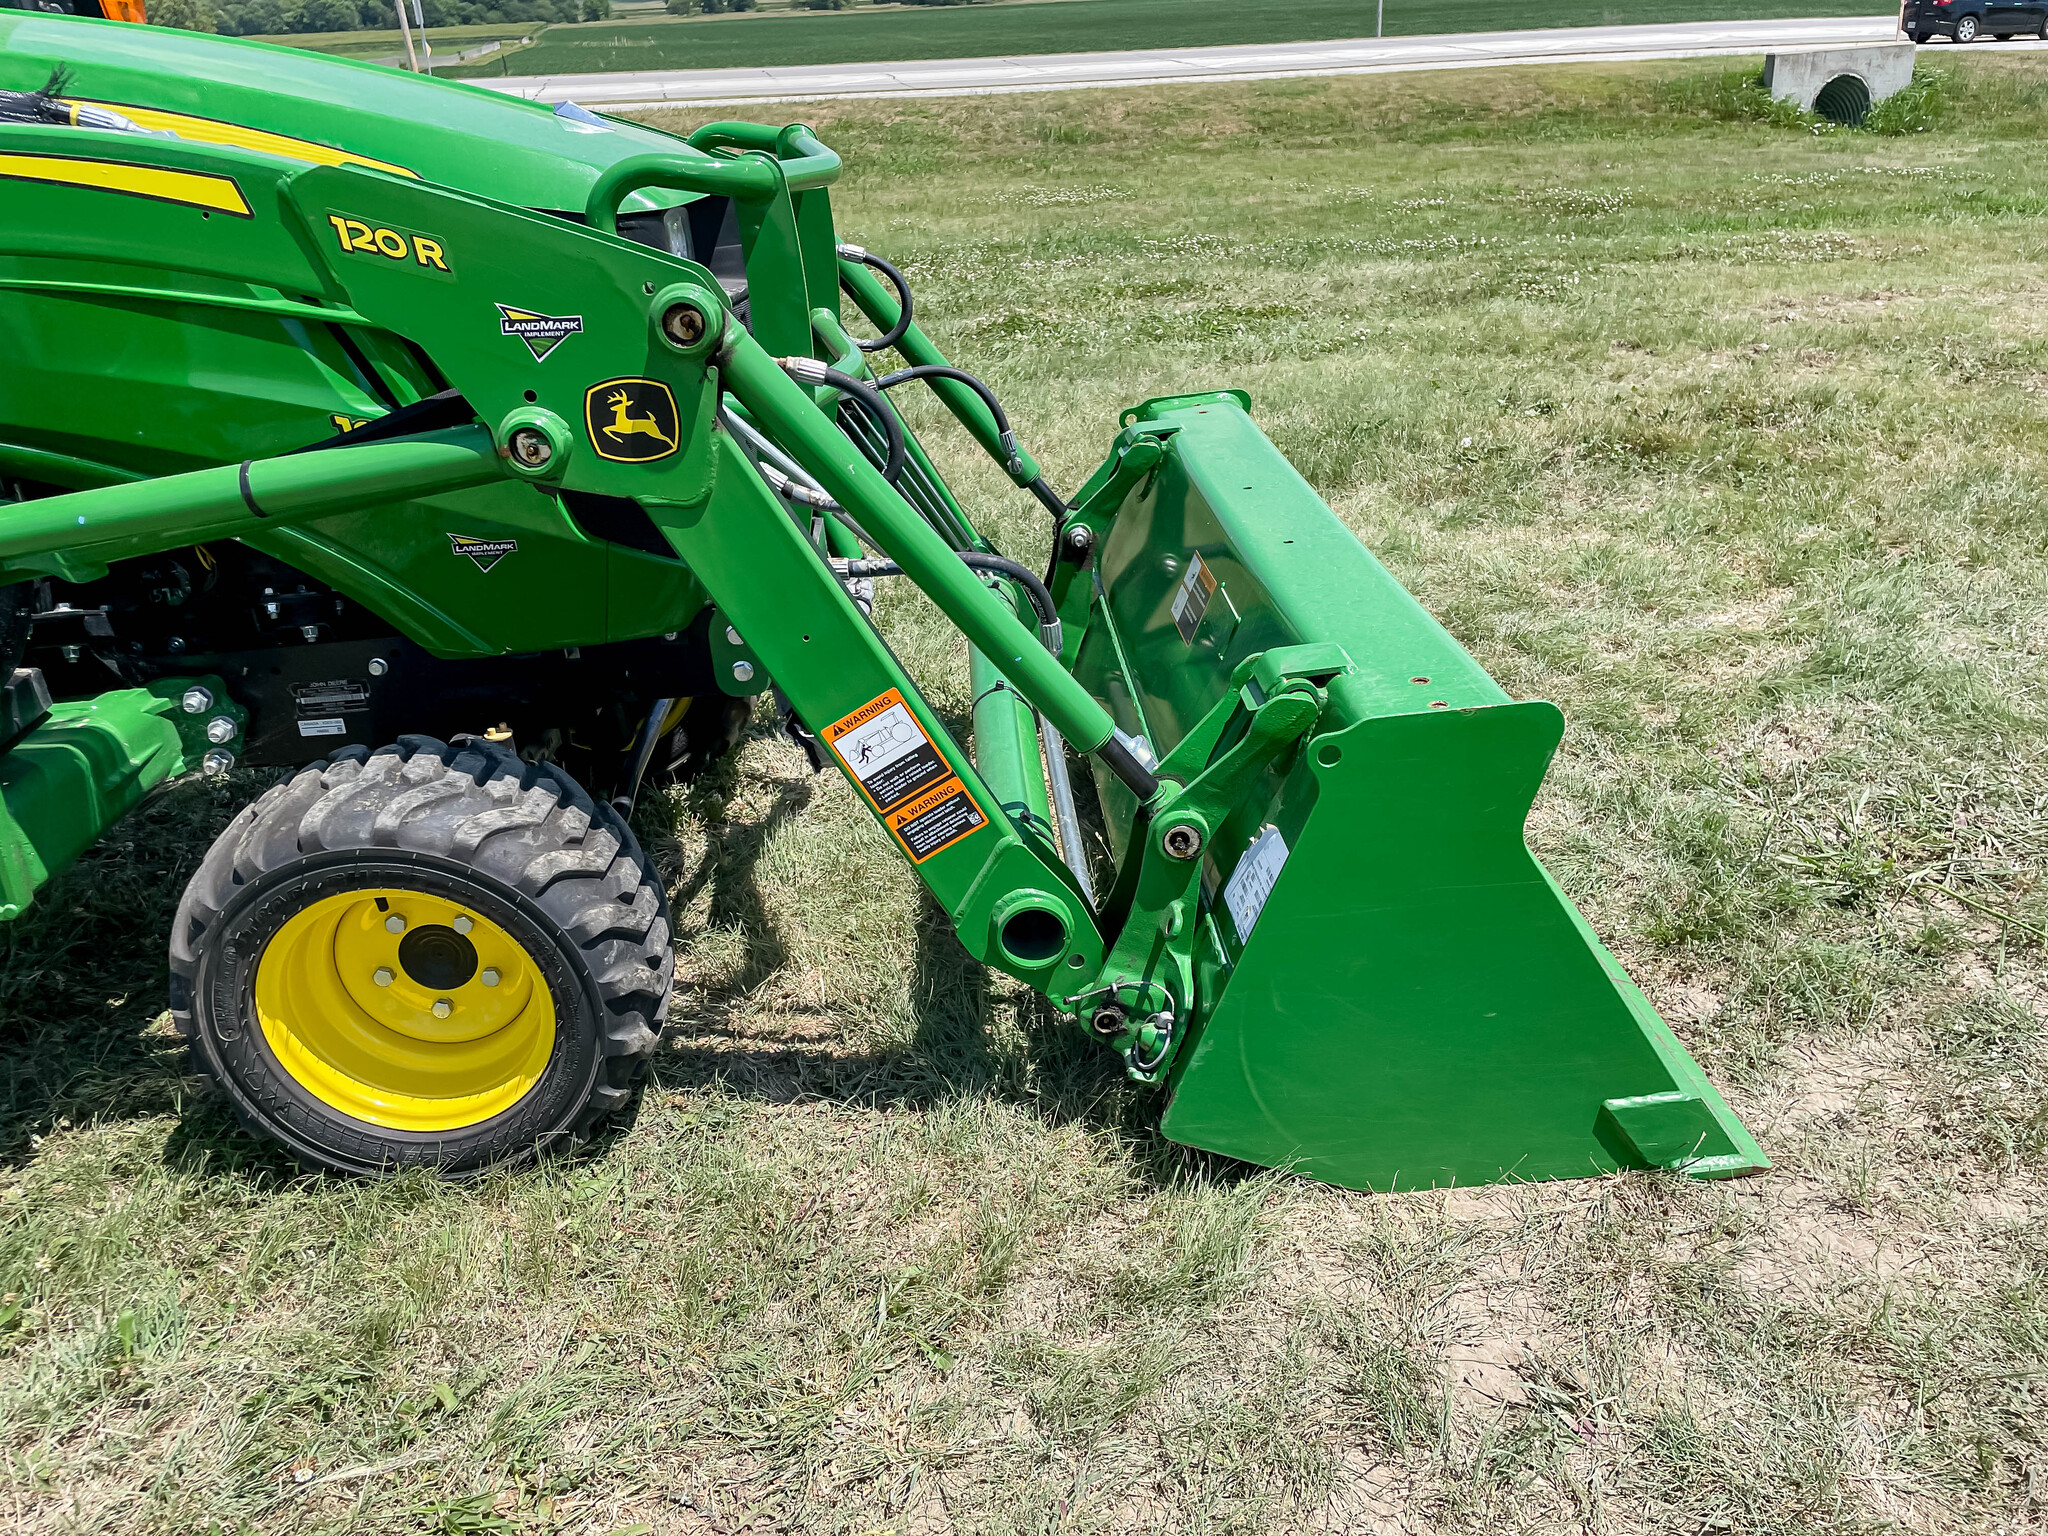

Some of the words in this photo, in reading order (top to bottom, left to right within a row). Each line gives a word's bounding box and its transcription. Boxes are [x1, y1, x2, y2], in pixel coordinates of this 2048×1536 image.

[327, 213, 409, 261] 120
[410, 234, 453, 273] R
[843, 696, 892, 729] WARNING
[907, 785, 955, 816] WARNING
